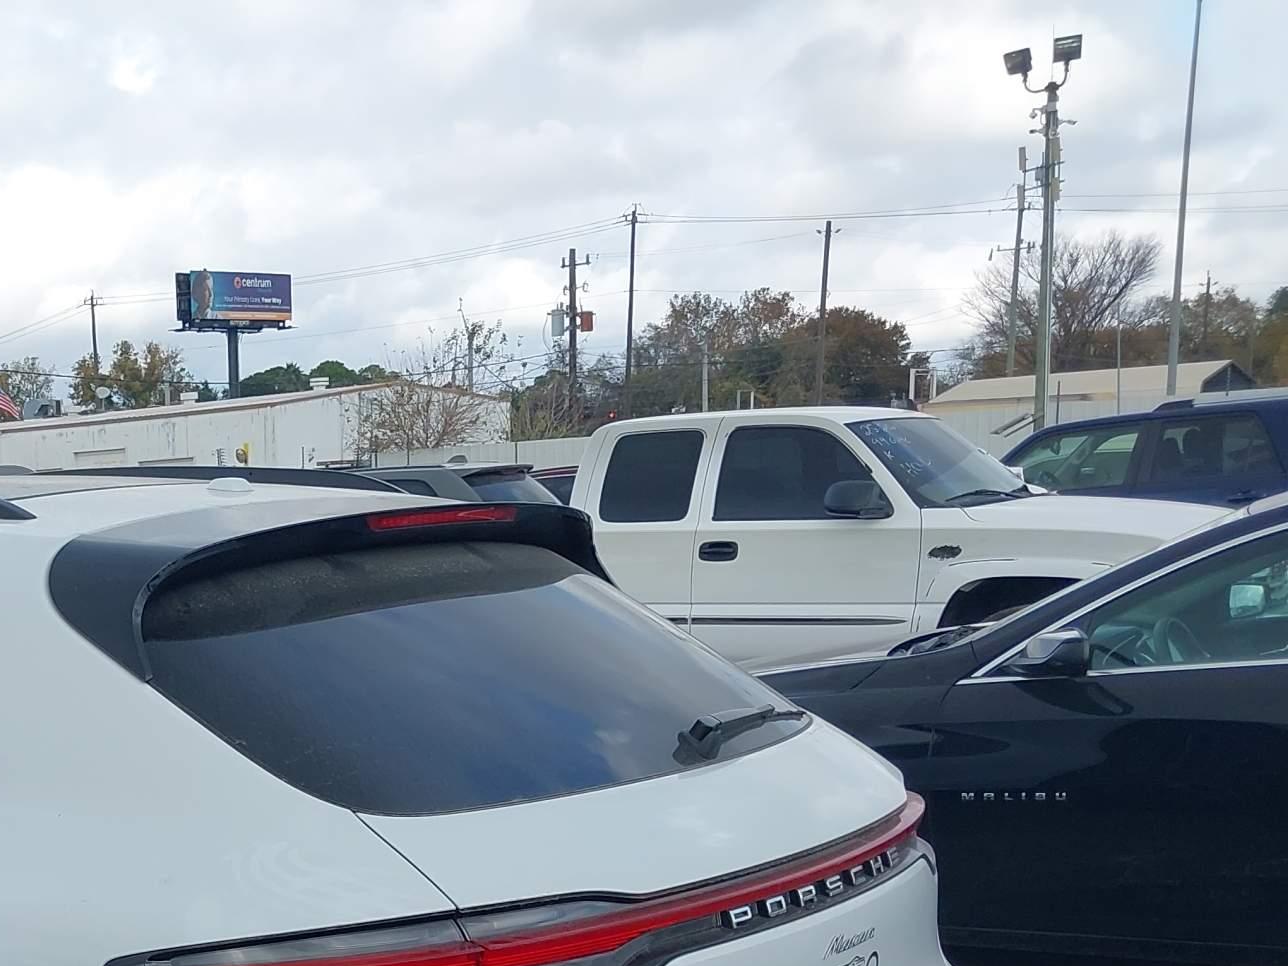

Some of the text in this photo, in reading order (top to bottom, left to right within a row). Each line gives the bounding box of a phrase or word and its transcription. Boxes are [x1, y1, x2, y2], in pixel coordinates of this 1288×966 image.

[242, 277, 272, 288] centrum
[961, 792, 1067, 801] MALIBU
[729, 846, 900, 929] PORSCHE
